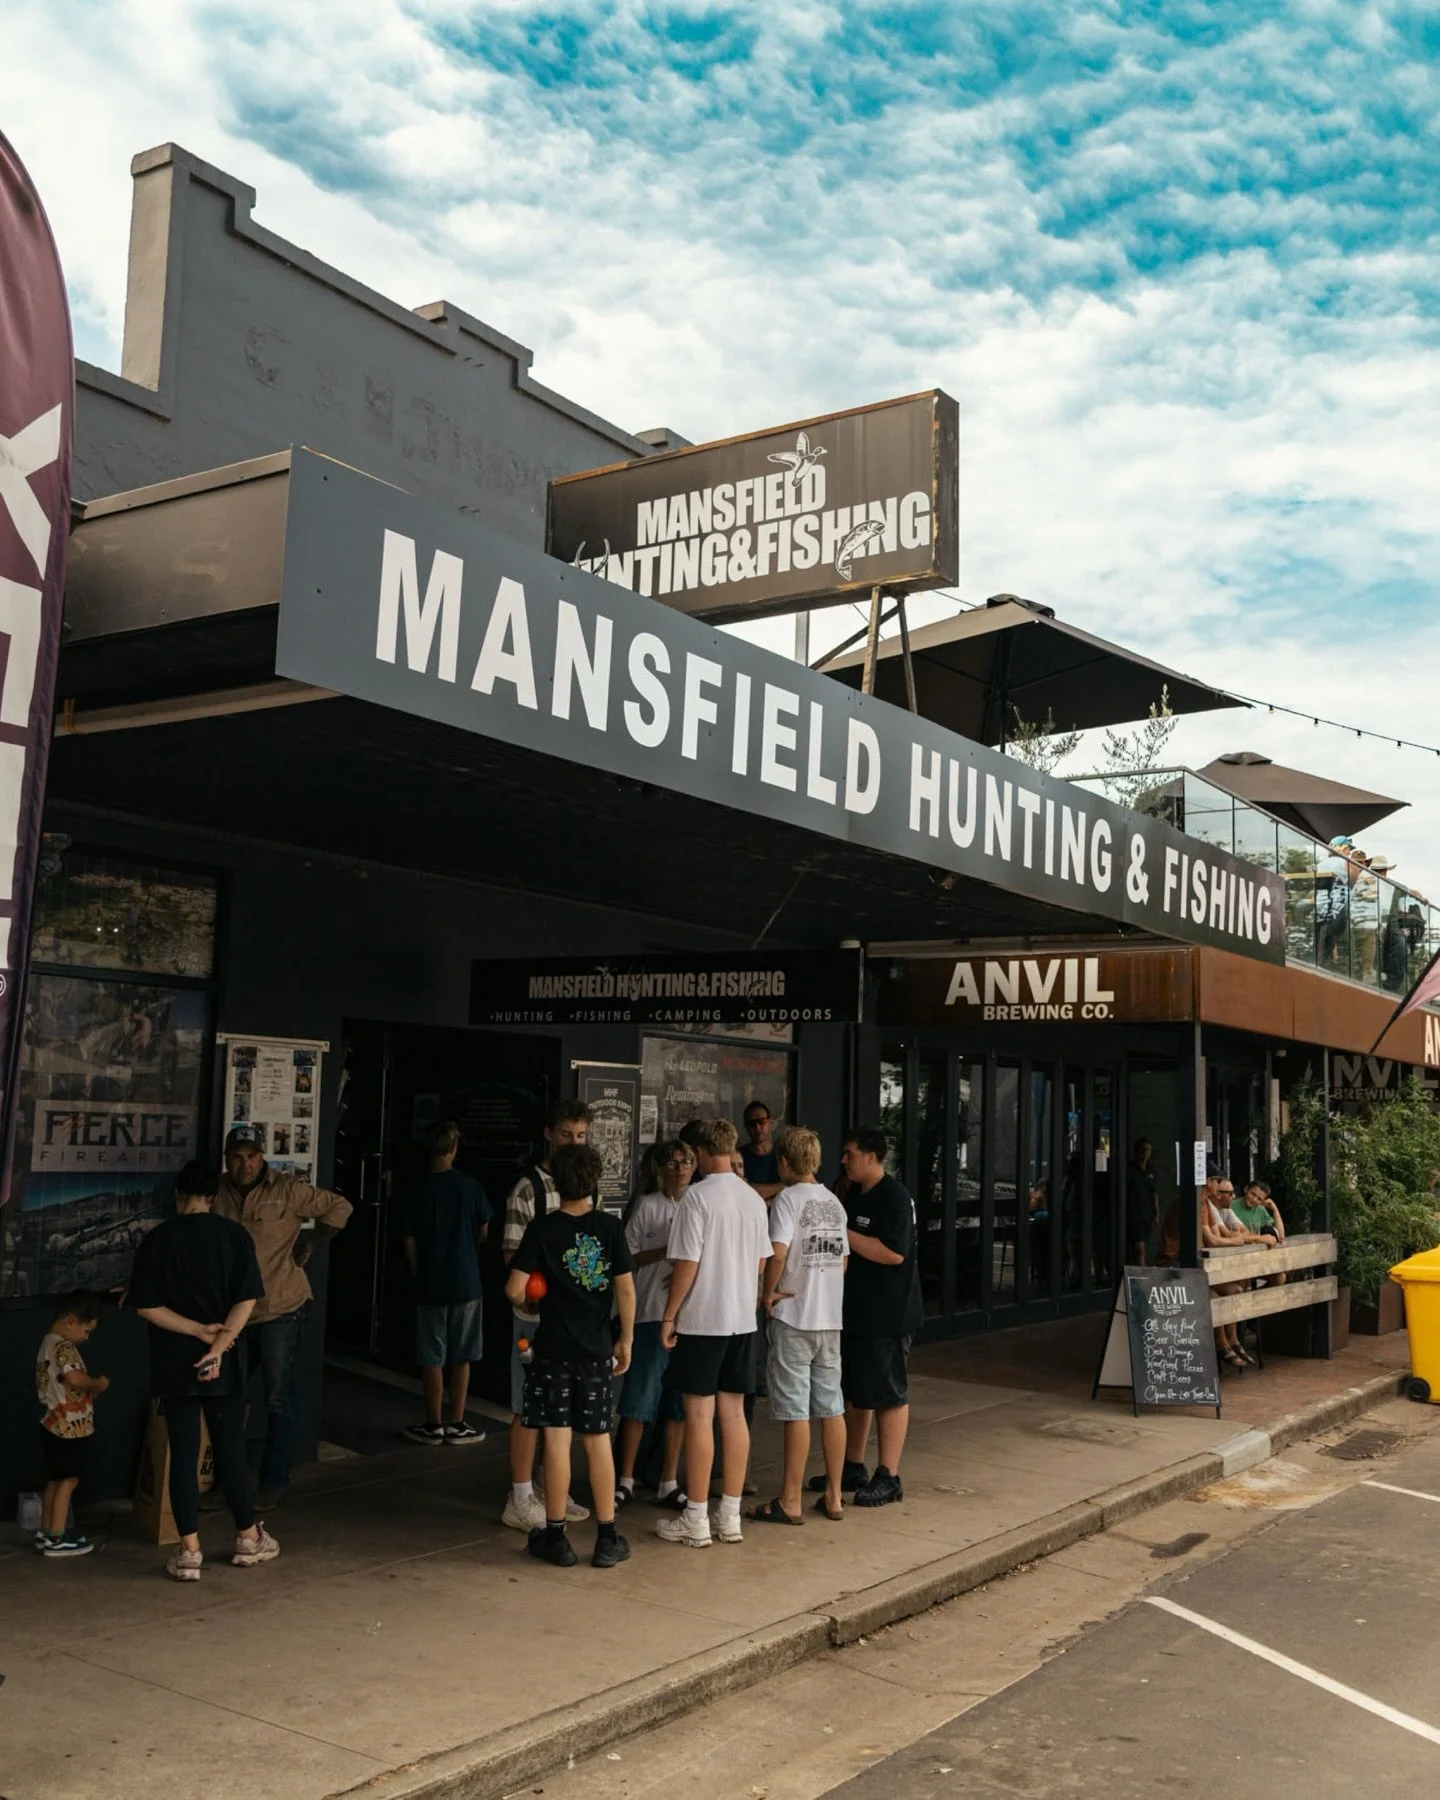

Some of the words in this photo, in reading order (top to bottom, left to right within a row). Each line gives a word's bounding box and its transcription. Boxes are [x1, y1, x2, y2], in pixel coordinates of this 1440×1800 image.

[636, 464, 826, 546] MANSFIELD
[375, 528, 882, 815] MANSFIELD
[909, 742, 1112, 893] HUNTING
[1126, 833, 1149, 905] &
[1163, 846, 1271, 944] FISHING
[528, 974, 614, 999] MANSFIELD
[944, 957, 1115, 1005] ANVIL
[495, 1011, 553, 1022] HUNTING
[575, 1010, 632, 1021] FISHING
[655, 1009, 722, 1021] CAMPING
[747, 1008, 832, 1020] OUTDOORS
[983, 1004, 1073, 1021] BREWING
[1081, 1003, 1115, 1020] CO.
[41, 1111, 190, 1147] FIERCE
[1148, 1286, 1195, 1305] ANVIL
